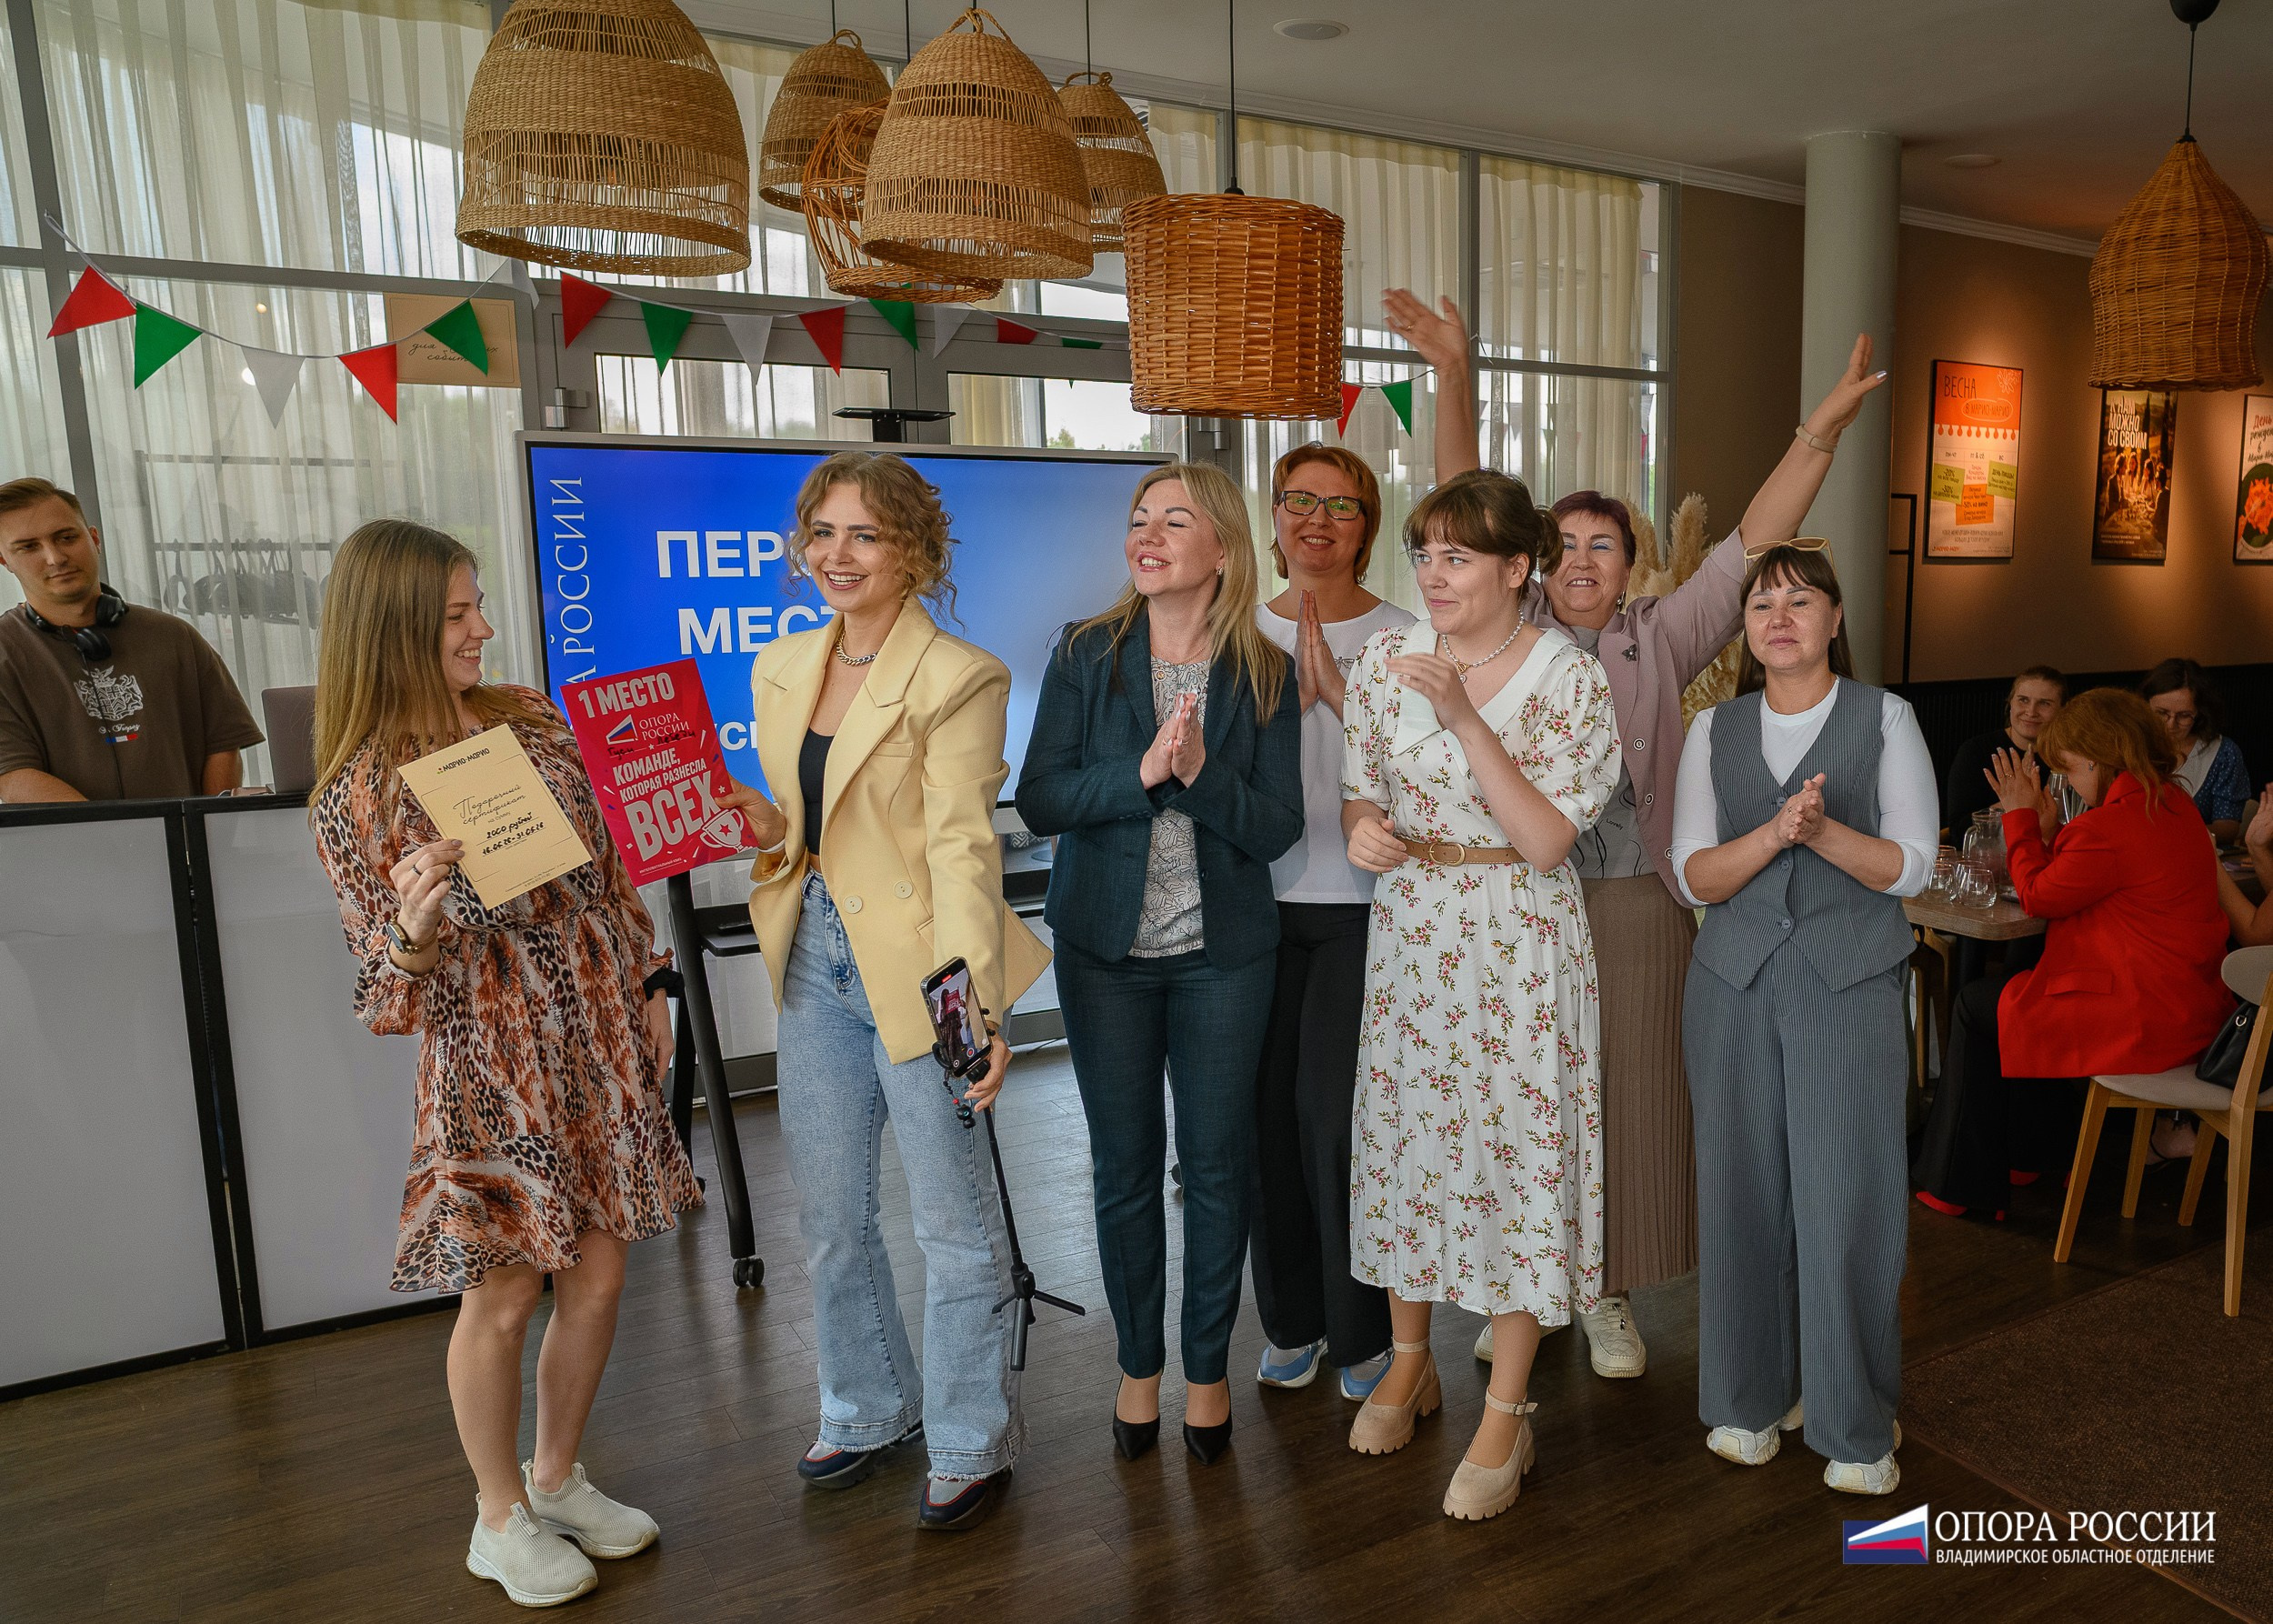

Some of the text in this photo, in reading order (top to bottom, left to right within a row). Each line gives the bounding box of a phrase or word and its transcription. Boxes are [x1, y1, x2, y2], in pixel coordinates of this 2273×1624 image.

[1944, 376, 1977, 399] ВЕСНА
[2110, 397, 2136, 416] К НАМ
[2109, 413, 2140, 432] МОЖНО
[2108, 429, 2148, 450] СО СВОИМ
[549, 476, 596, 656] РОССИИ
[577, 689, 596, 718] 1
[595, 672, 676, 716] МЕСТО
[639, 712, 680, 730] ОПОРА
[641, 721, 690, 741] РОССИИ
[443, 747, 490, 771] МАРИО-МАРИО
[612, 747, 681, 787] КОМАНДЕ,
[619, 757, 707, 804] КОТОРАЯ РАЗНЕСЛА
[453, 784, 522, 818] Подарочный
[463, 795, 526, 826] сертификат
[624, 770, 722, 862] ВСЕХ
